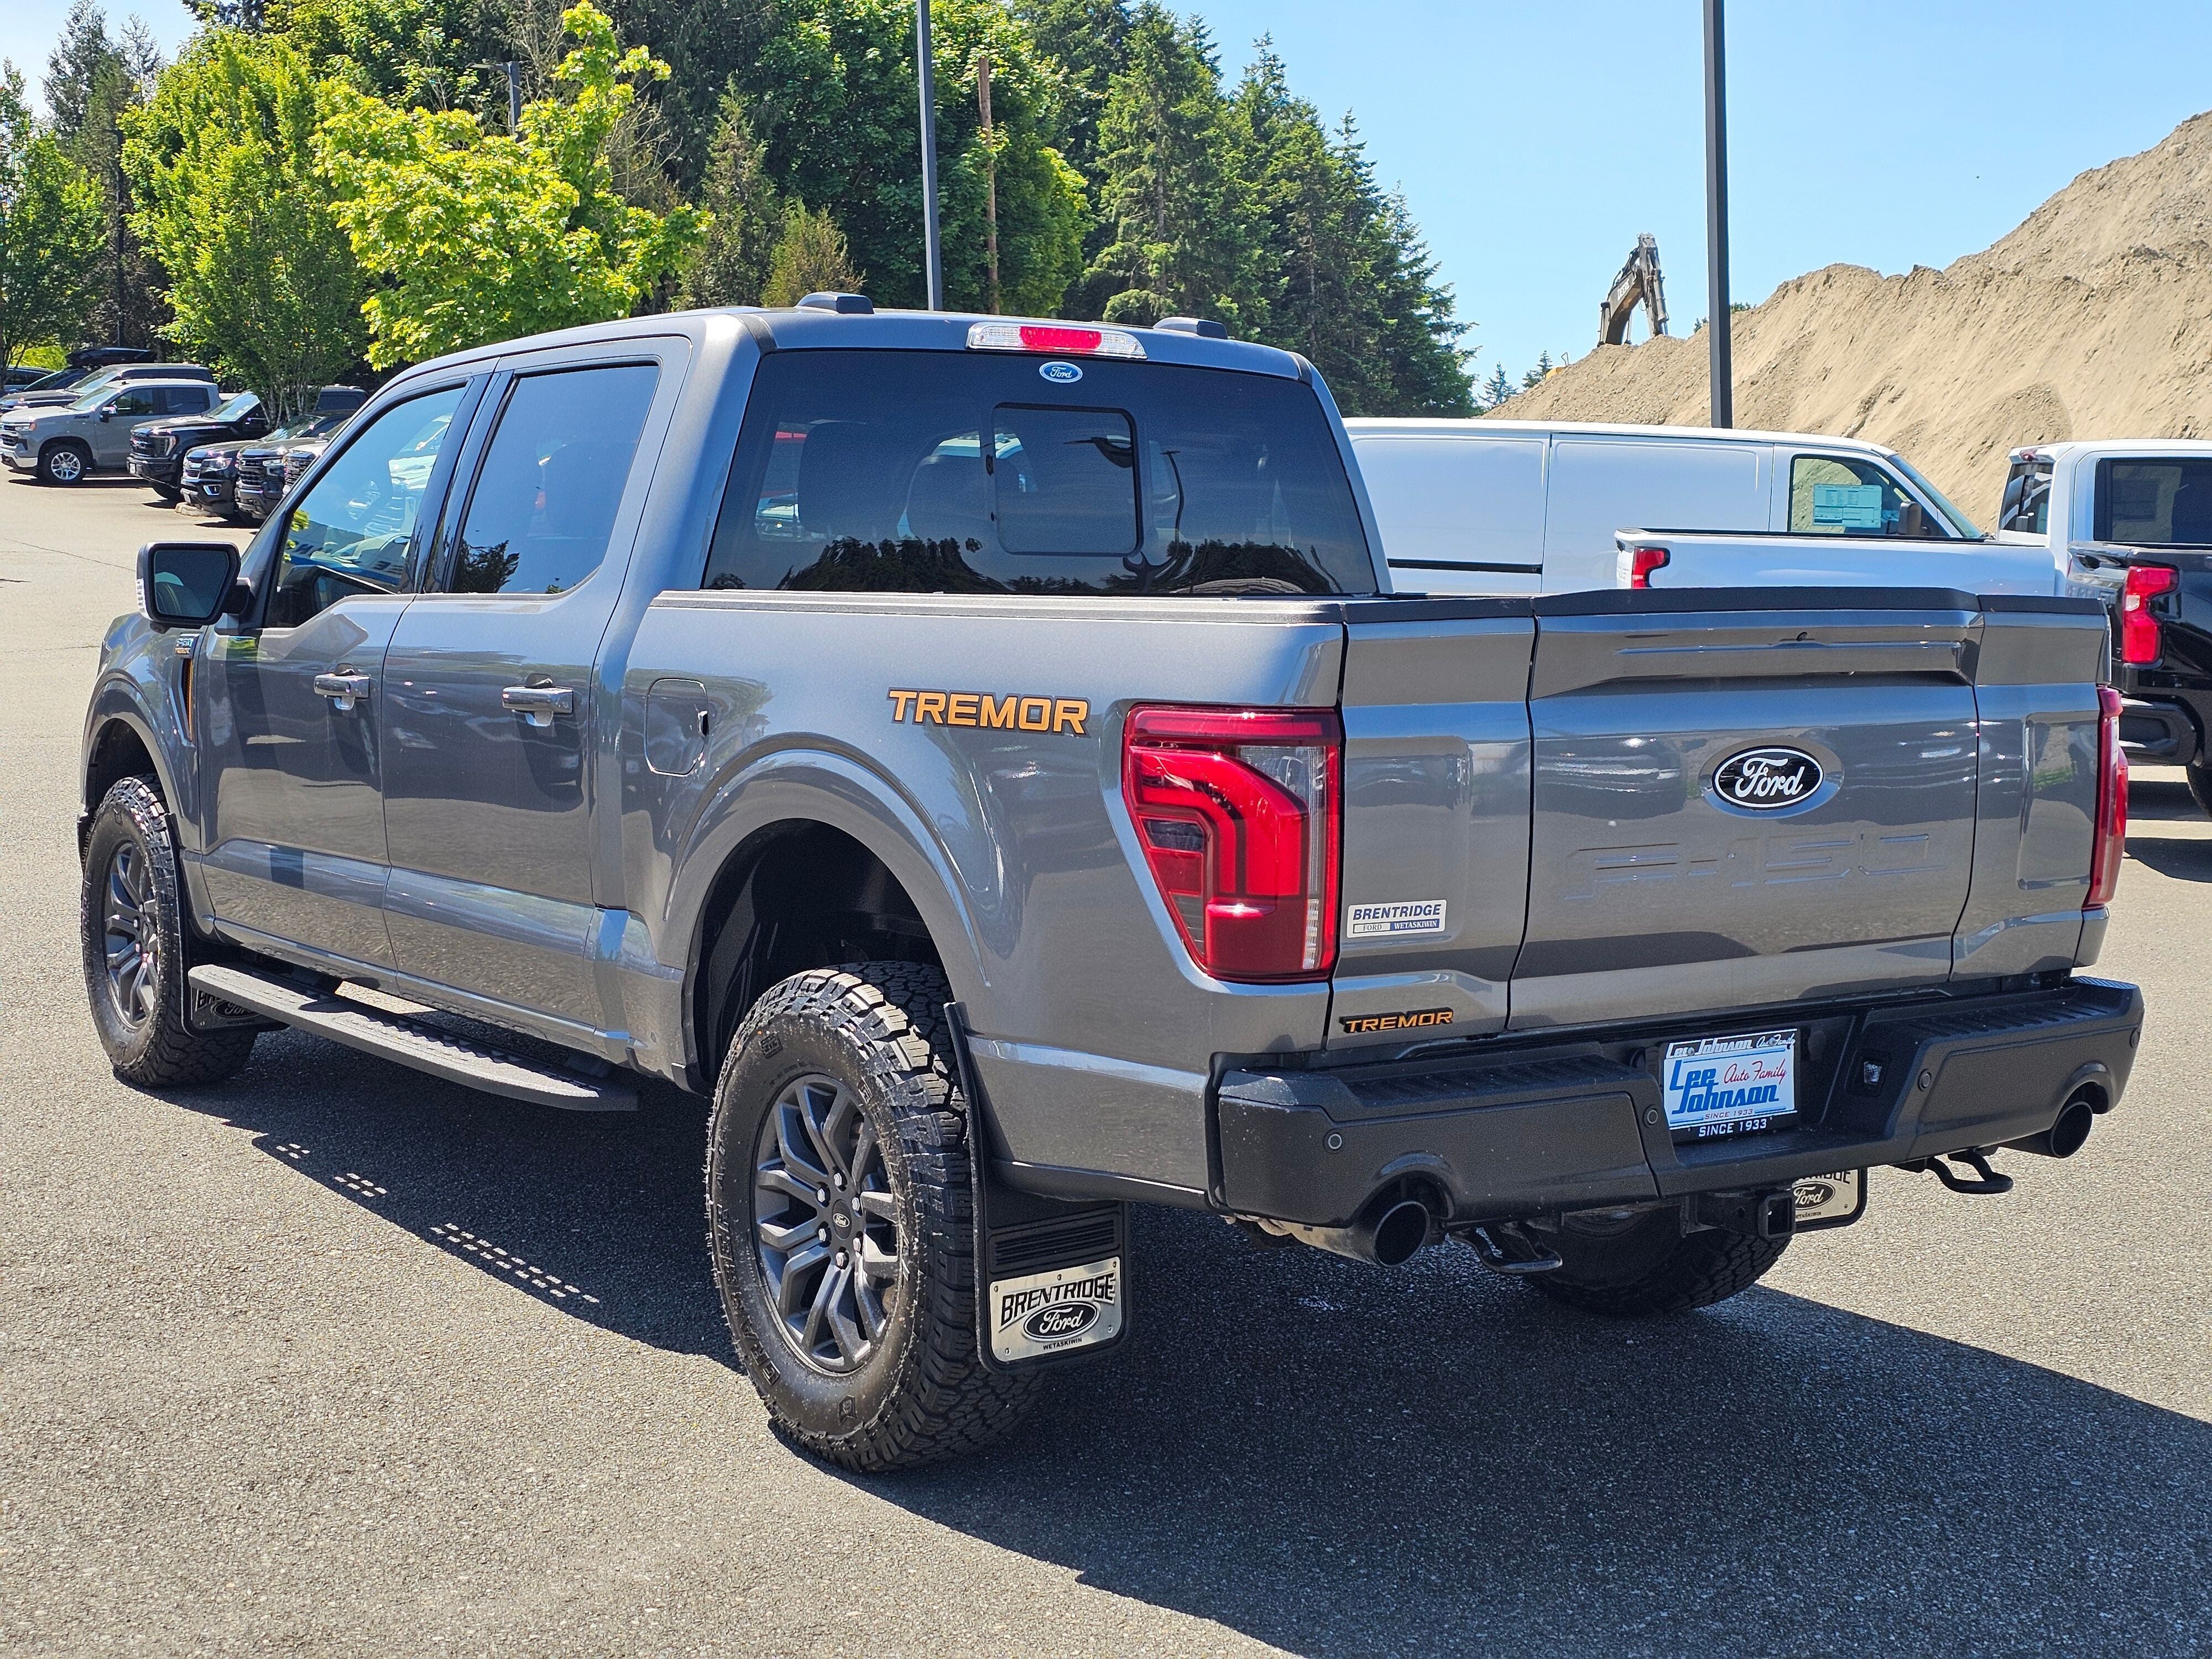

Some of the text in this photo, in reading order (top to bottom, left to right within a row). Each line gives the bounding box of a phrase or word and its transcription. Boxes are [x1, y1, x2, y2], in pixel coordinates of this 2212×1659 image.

[1050, 366, 1073, 379] Ford
[888, 689, 1089, 735] TREMOR
[1735, 757, 1803, 798] Ford
[1353, 904, 1442, 920] BRENTRIDGE
[1362, 920, 1437, 931] FORD WETASKIWIN
[1345, 1011, 1454, 1033] TREMOR
[1694, 1038, 1753, 1055] Johnson
[1669, 1058, 1787, 1091] Lee Auto Family
[1672, 1082, 1779, 1115] Johnson
[1704, 1112, 1730, 1120] SINCE
[1699, 1118, 1767, 1138] SINCE 1933
[1793, 1186, 1824, 1205] Ford
[1000, 1272, 1116, 1327] BRENTRIDGE
[1039, 1307, 1084, 1334] Ford
[1042, 1337, 1083, 1350] WETASKIWIN
